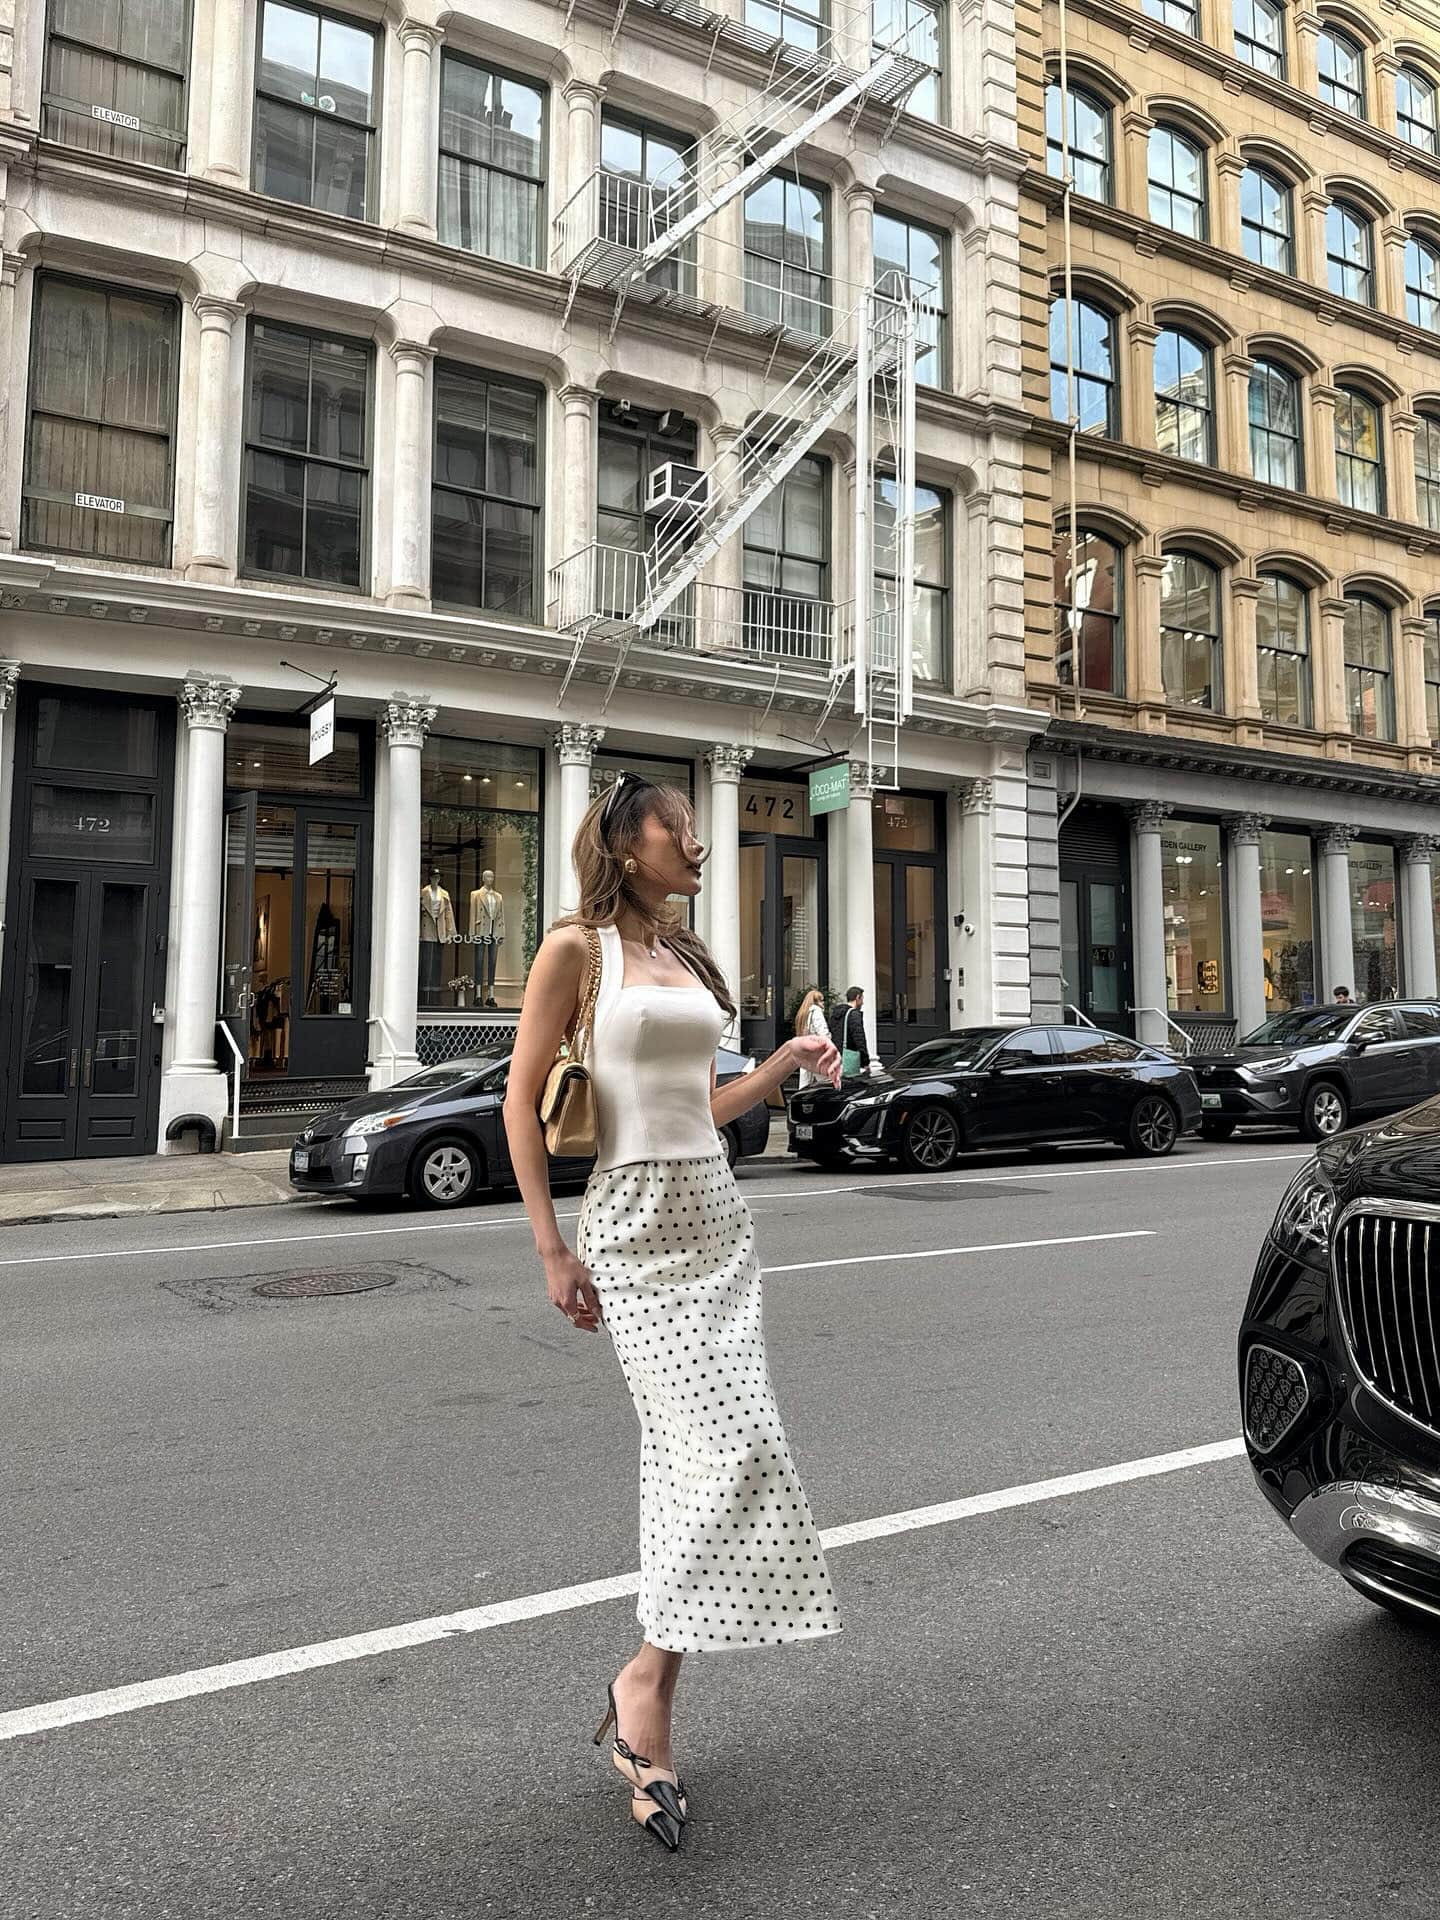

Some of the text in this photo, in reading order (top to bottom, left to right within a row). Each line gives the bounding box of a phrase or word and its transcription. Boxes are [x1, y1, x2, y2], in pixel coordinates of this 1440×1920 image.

[93, 107, 138, 128] ELEVATOR
[77, 494, 122, 511] ELEVATOR
[745, 794, 794, 819] 472
[72, 816, 110, 832] 472
[887, 815, 908, 829] 472
[1178, 841, 1208, 851] GALLERY
